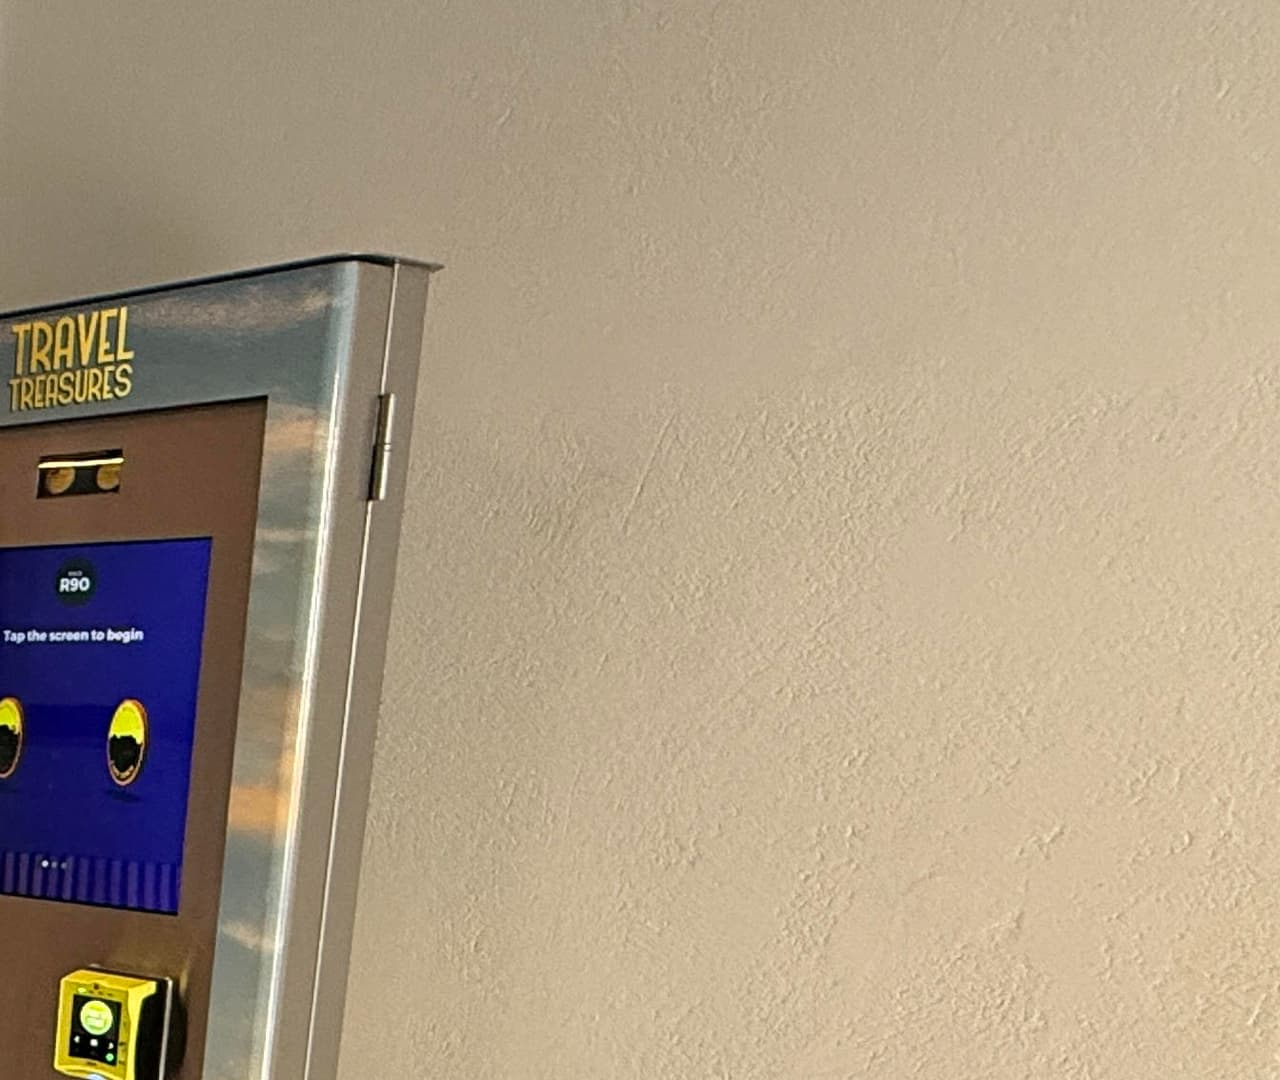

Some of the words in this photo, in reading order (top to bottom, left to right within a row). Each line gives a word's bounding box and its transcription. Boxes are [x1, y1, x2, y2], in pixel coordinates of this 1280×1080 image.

[12, 306, 135, 374] TRAVEL
[9, 364, 133, 412] TREASURES
[59, 577, 91, 593] R90
[3, 630, 25, 643] Tap
[27, 629, 47, 642] the
[48, 631, 89, 642] screen
[91, 629, 105, 641] to
[107, 628, 144, 643] begin
